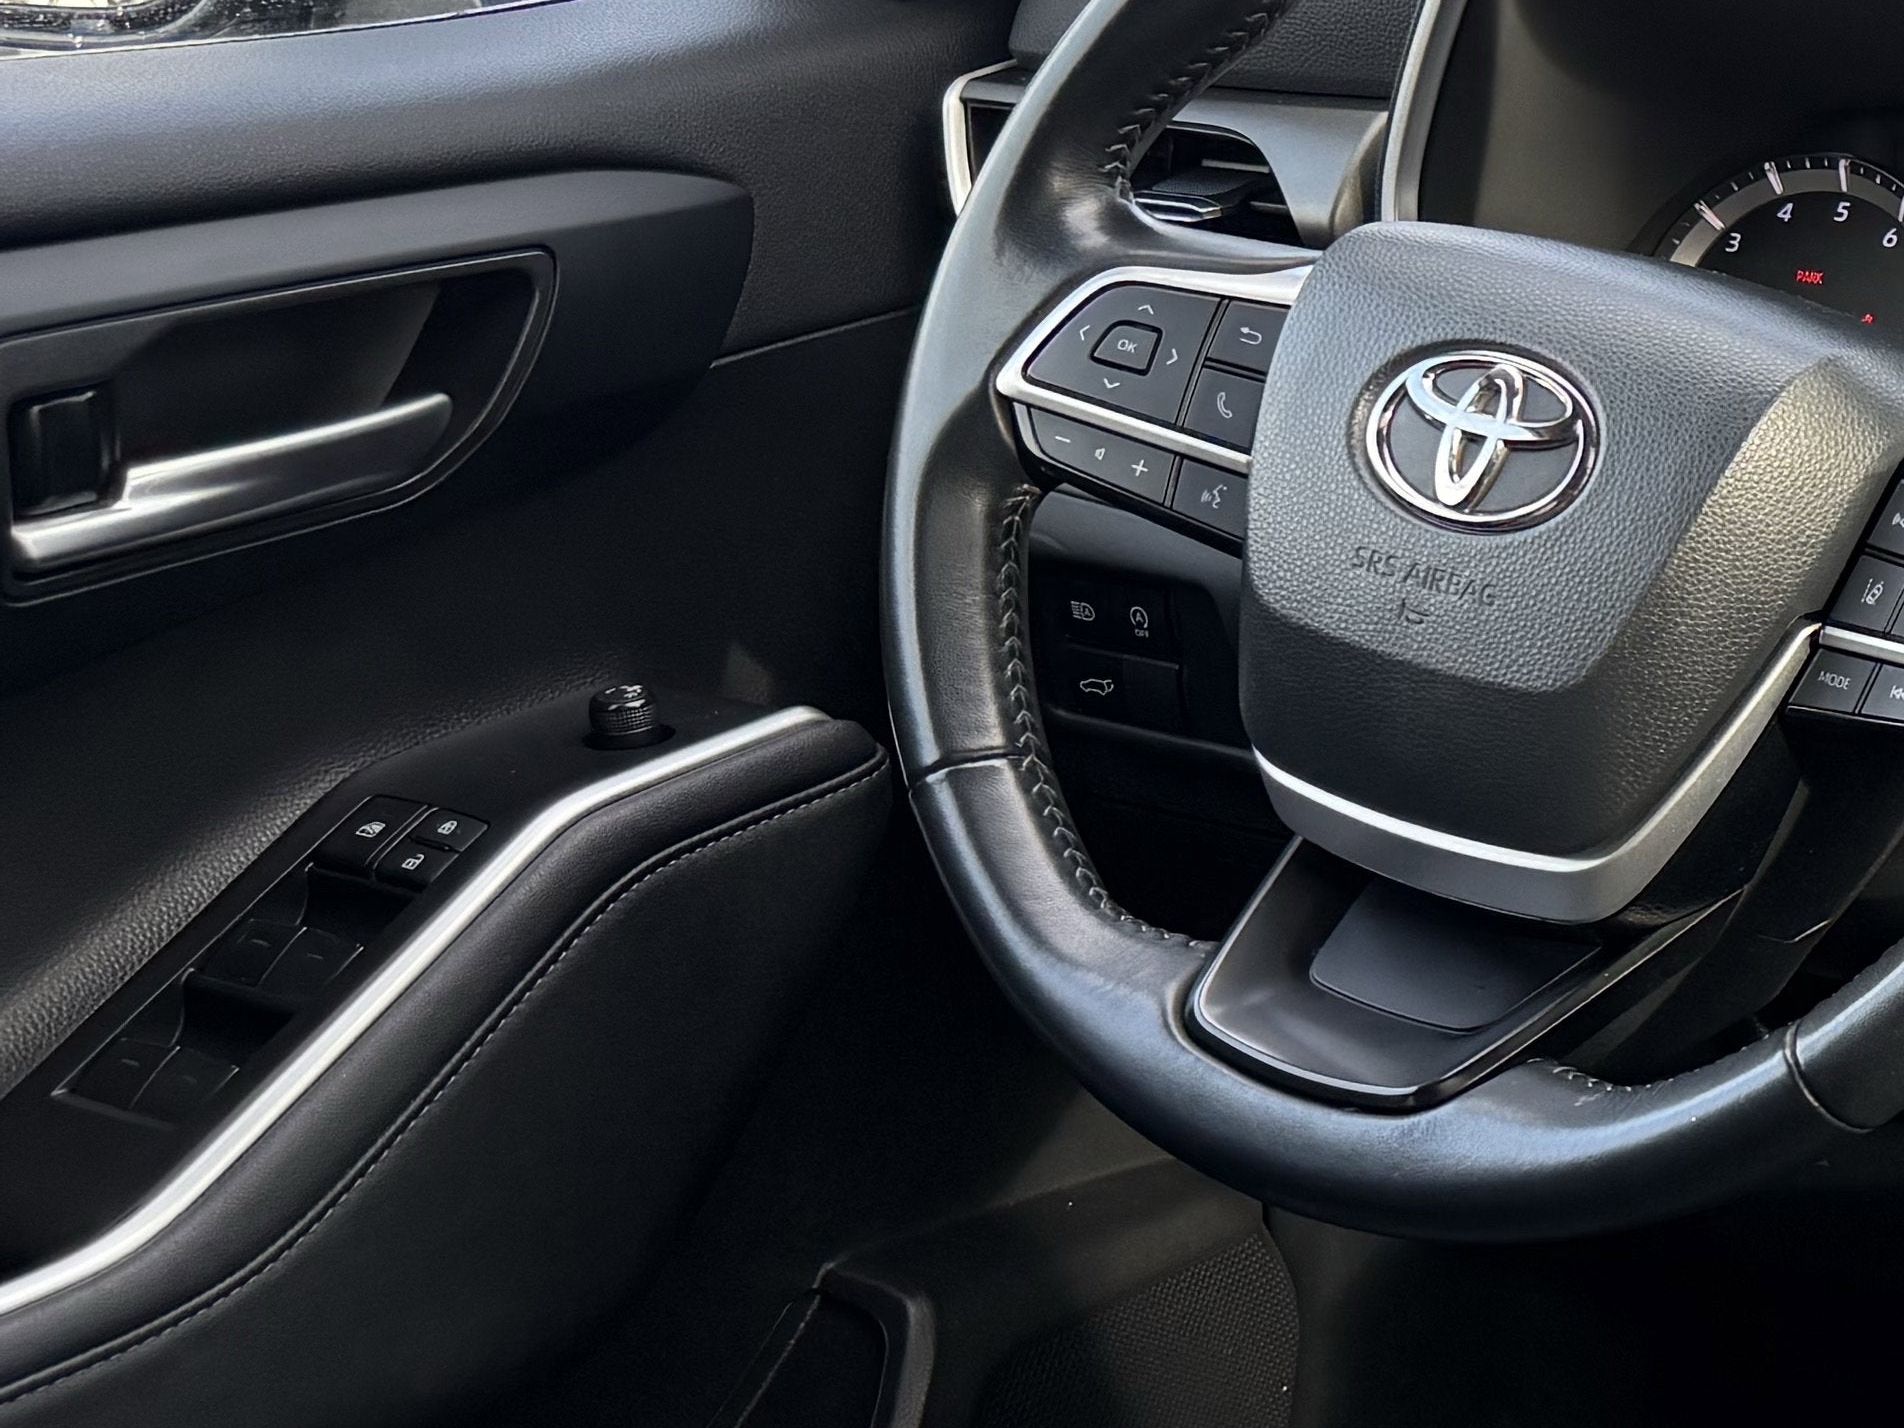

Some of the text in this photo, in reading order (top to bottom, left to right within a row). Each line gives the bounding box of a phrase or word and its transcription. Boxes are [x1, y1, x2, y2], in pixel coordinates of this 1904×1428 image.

[1777, 202, 1793, 222] 4
[1833, 202, 1850, 222] 5
[1725, 232, 1741, 253] 3
[1882, 228, 1898, 248] 6
[1117, 339, 1138, 354] OK
[1352, 546, 1496, 607] SRS AIRBAG
[1818, 671, 1851, 690] MODE
